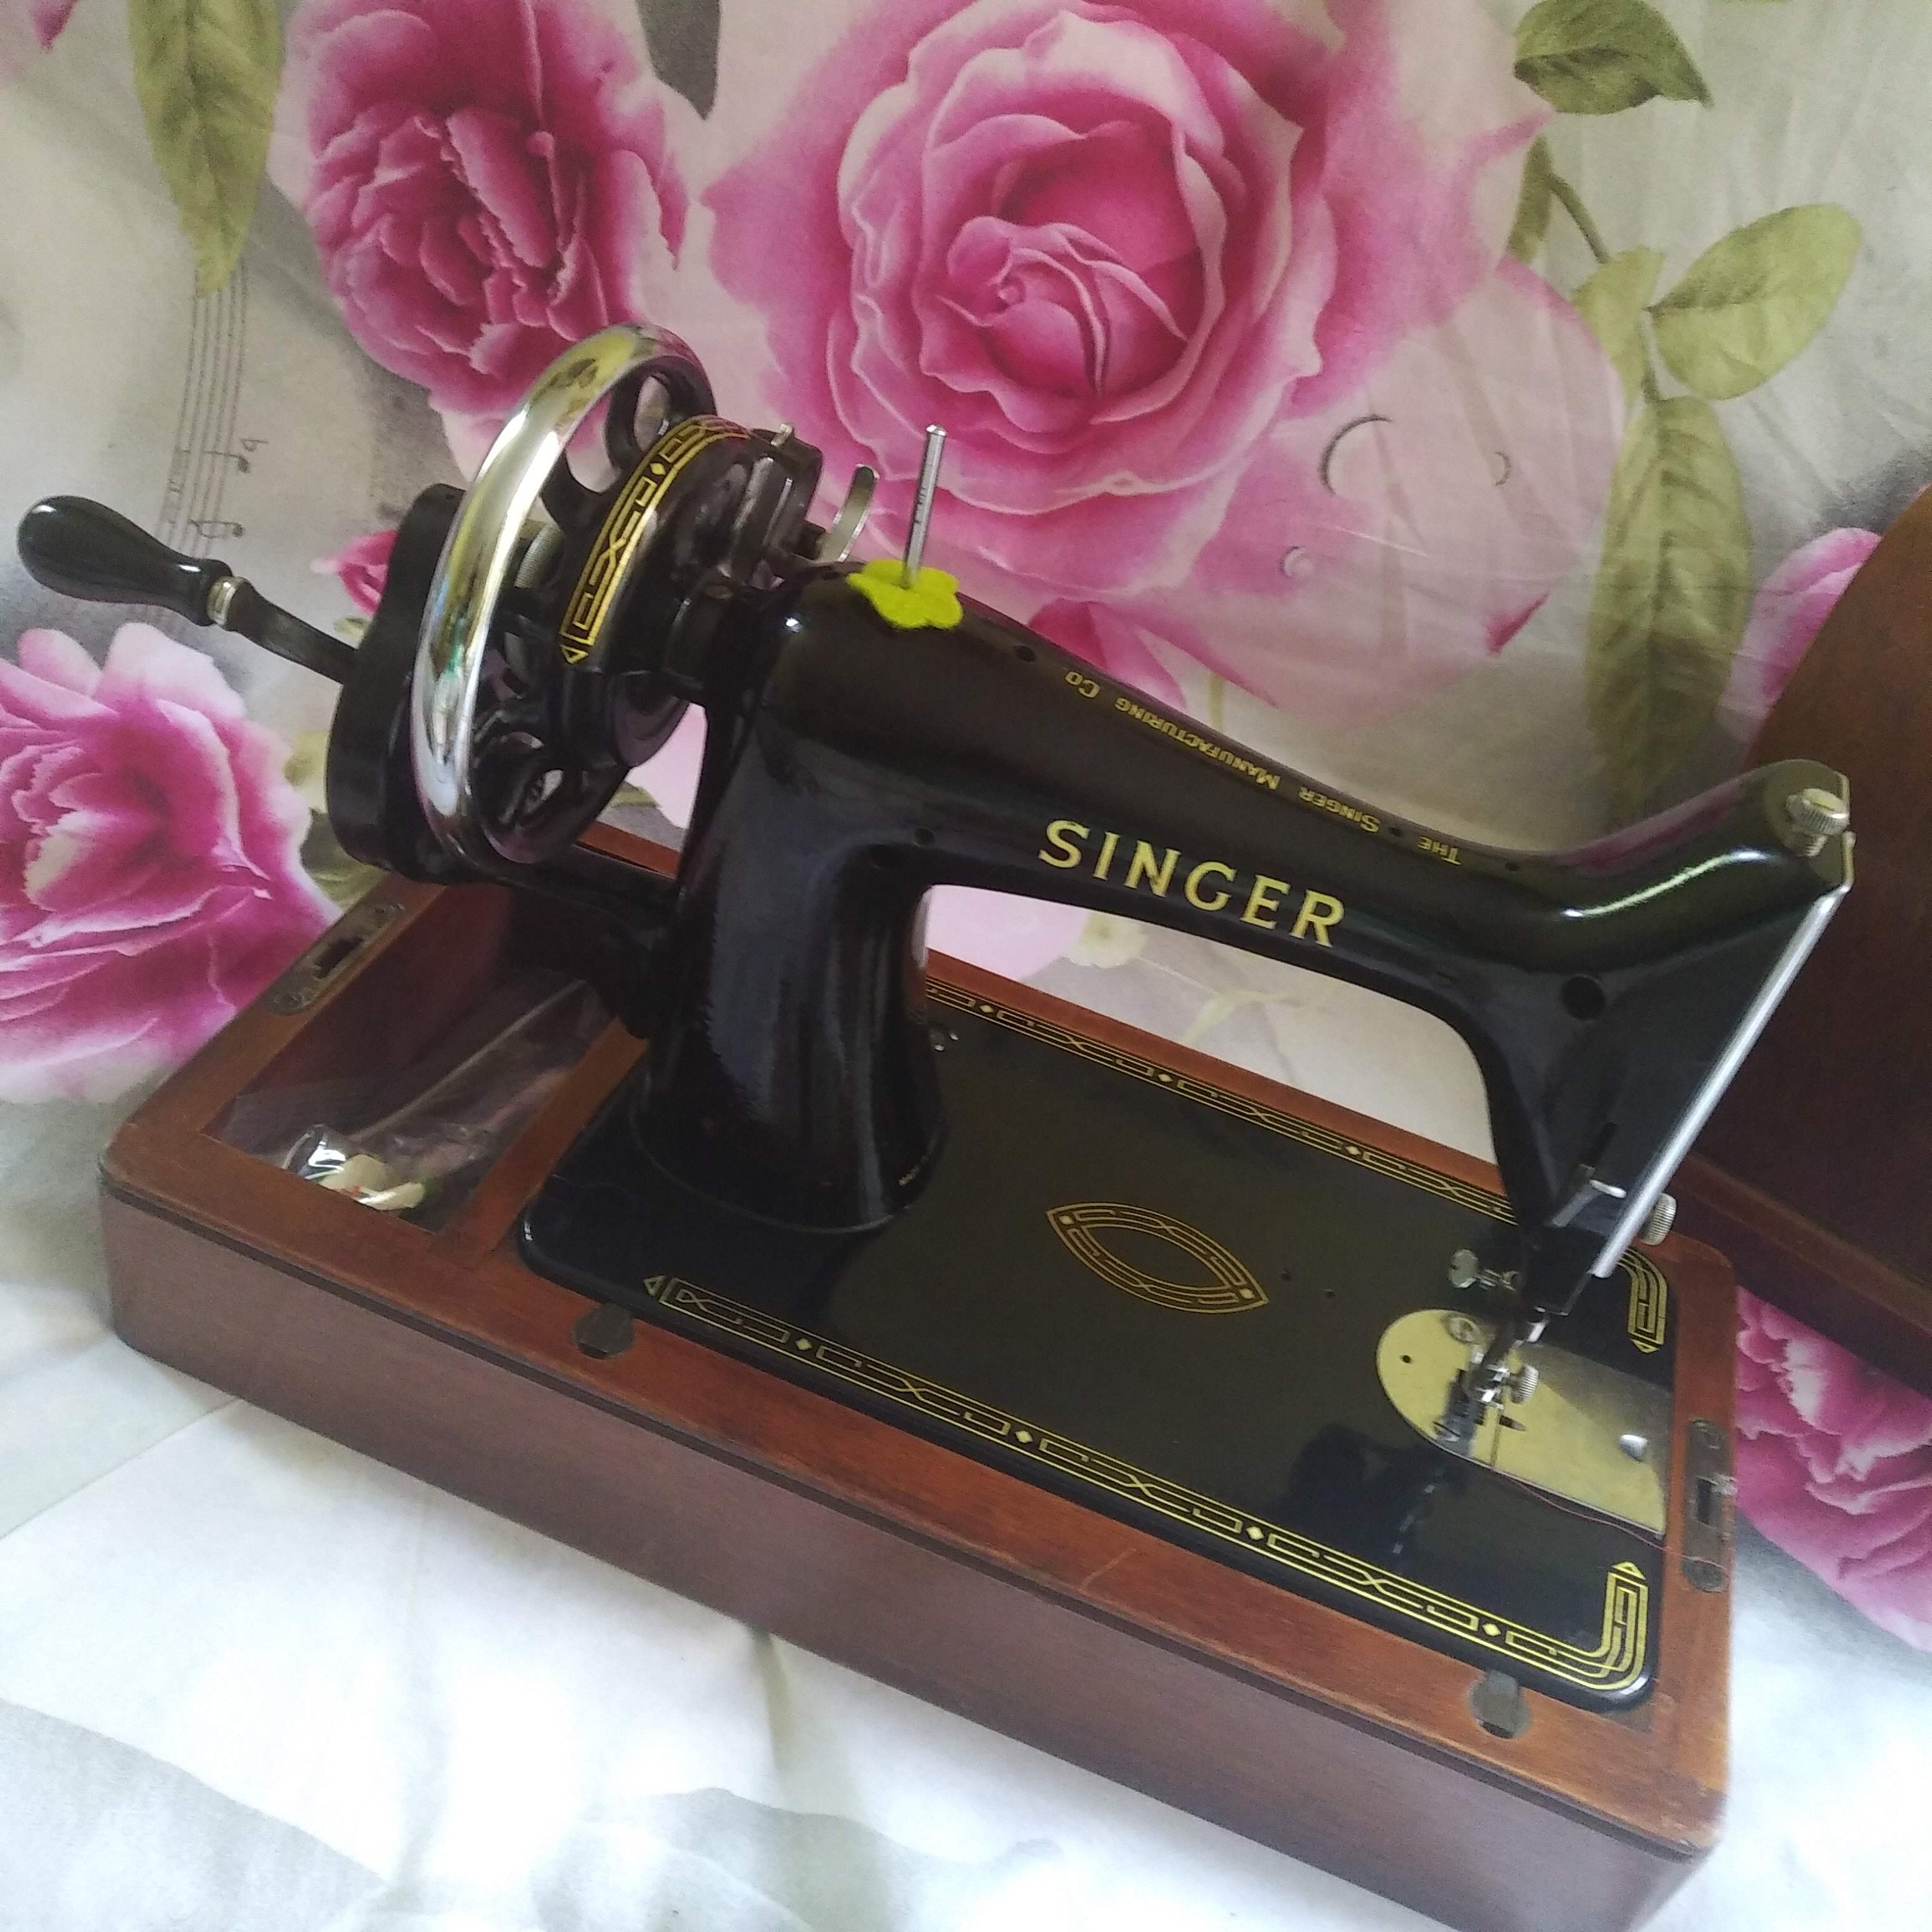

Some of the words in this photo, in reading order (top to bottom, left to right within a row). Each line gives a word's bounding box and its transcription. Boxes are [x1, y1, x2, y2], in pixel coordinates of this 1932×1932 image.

[1114, 697, 1282, 790] MANUFACTURING
[1298, 787, 1381, 833] SINGER
[1037, 819, 1345, 948] SINGER
[1417, 837, 1462, 866] THE
